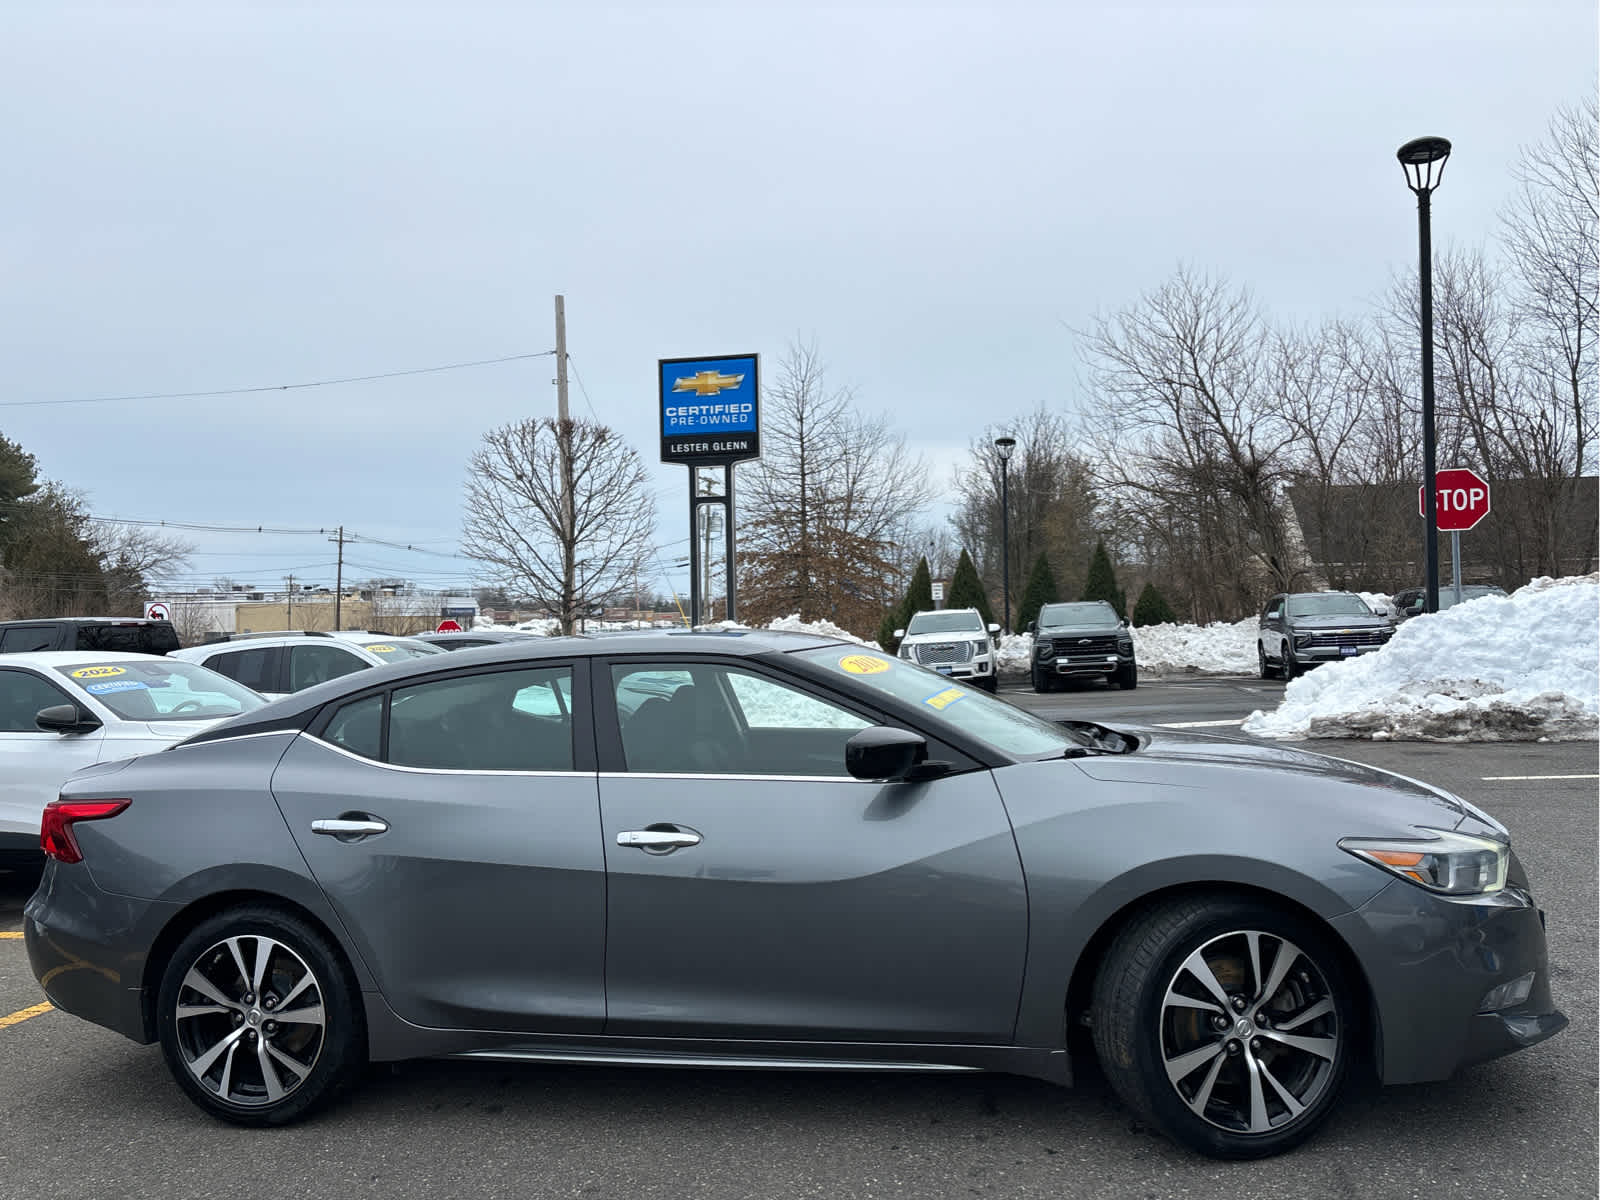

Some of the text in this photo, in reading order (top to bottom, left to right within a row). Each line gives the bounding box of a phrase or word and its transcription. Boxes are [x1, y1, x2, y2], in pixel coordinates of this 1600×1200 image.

[666, 403, 753, 417] CERTIFIED
[670, 414, 748, 426] PRE-OWNED
[671, 441, 748, 453] LESTER GLENN
[1436, 488, 1484, 511] TOP
[79, 667, 121, 677] 2024
